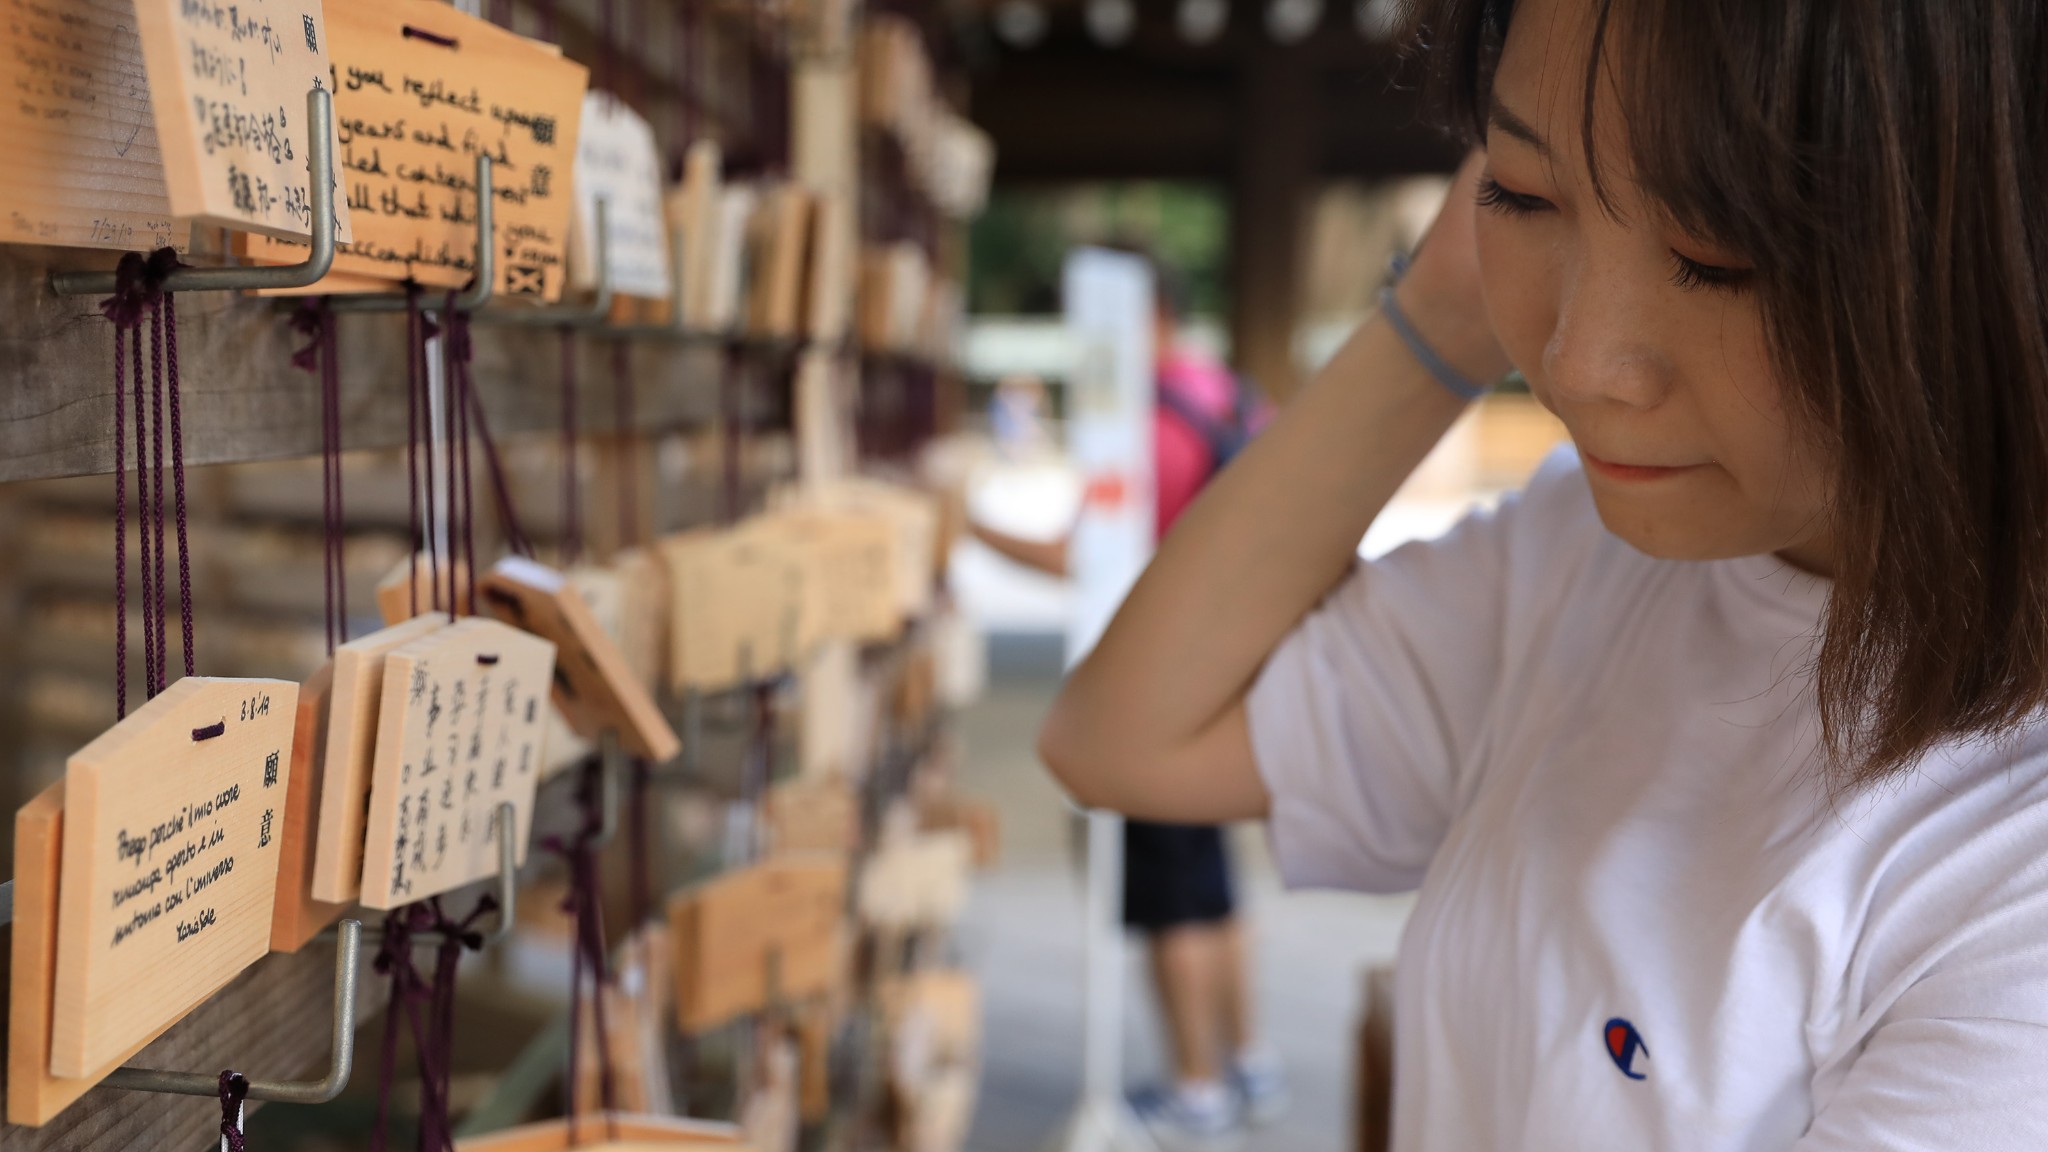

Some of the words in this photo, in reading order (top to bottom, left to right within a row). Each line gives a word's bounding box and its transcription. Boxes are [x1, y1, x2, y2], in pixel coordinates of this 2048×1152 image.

[346, 64, 392, 94] you
[403, 75, 482, 114] reflect
[337, 115, 405, 144] years
[413, 123, 456, 152] and
[380, 185, 431, 221] that
[194, 800, 213, 822] mio
[215, 783, 241, 812] cuore
[166, 841, 196, 886] aperto
[197, 835, 207, 854] e
[208, 819, 225, 850] in
[165, 890, 183, 913] con
